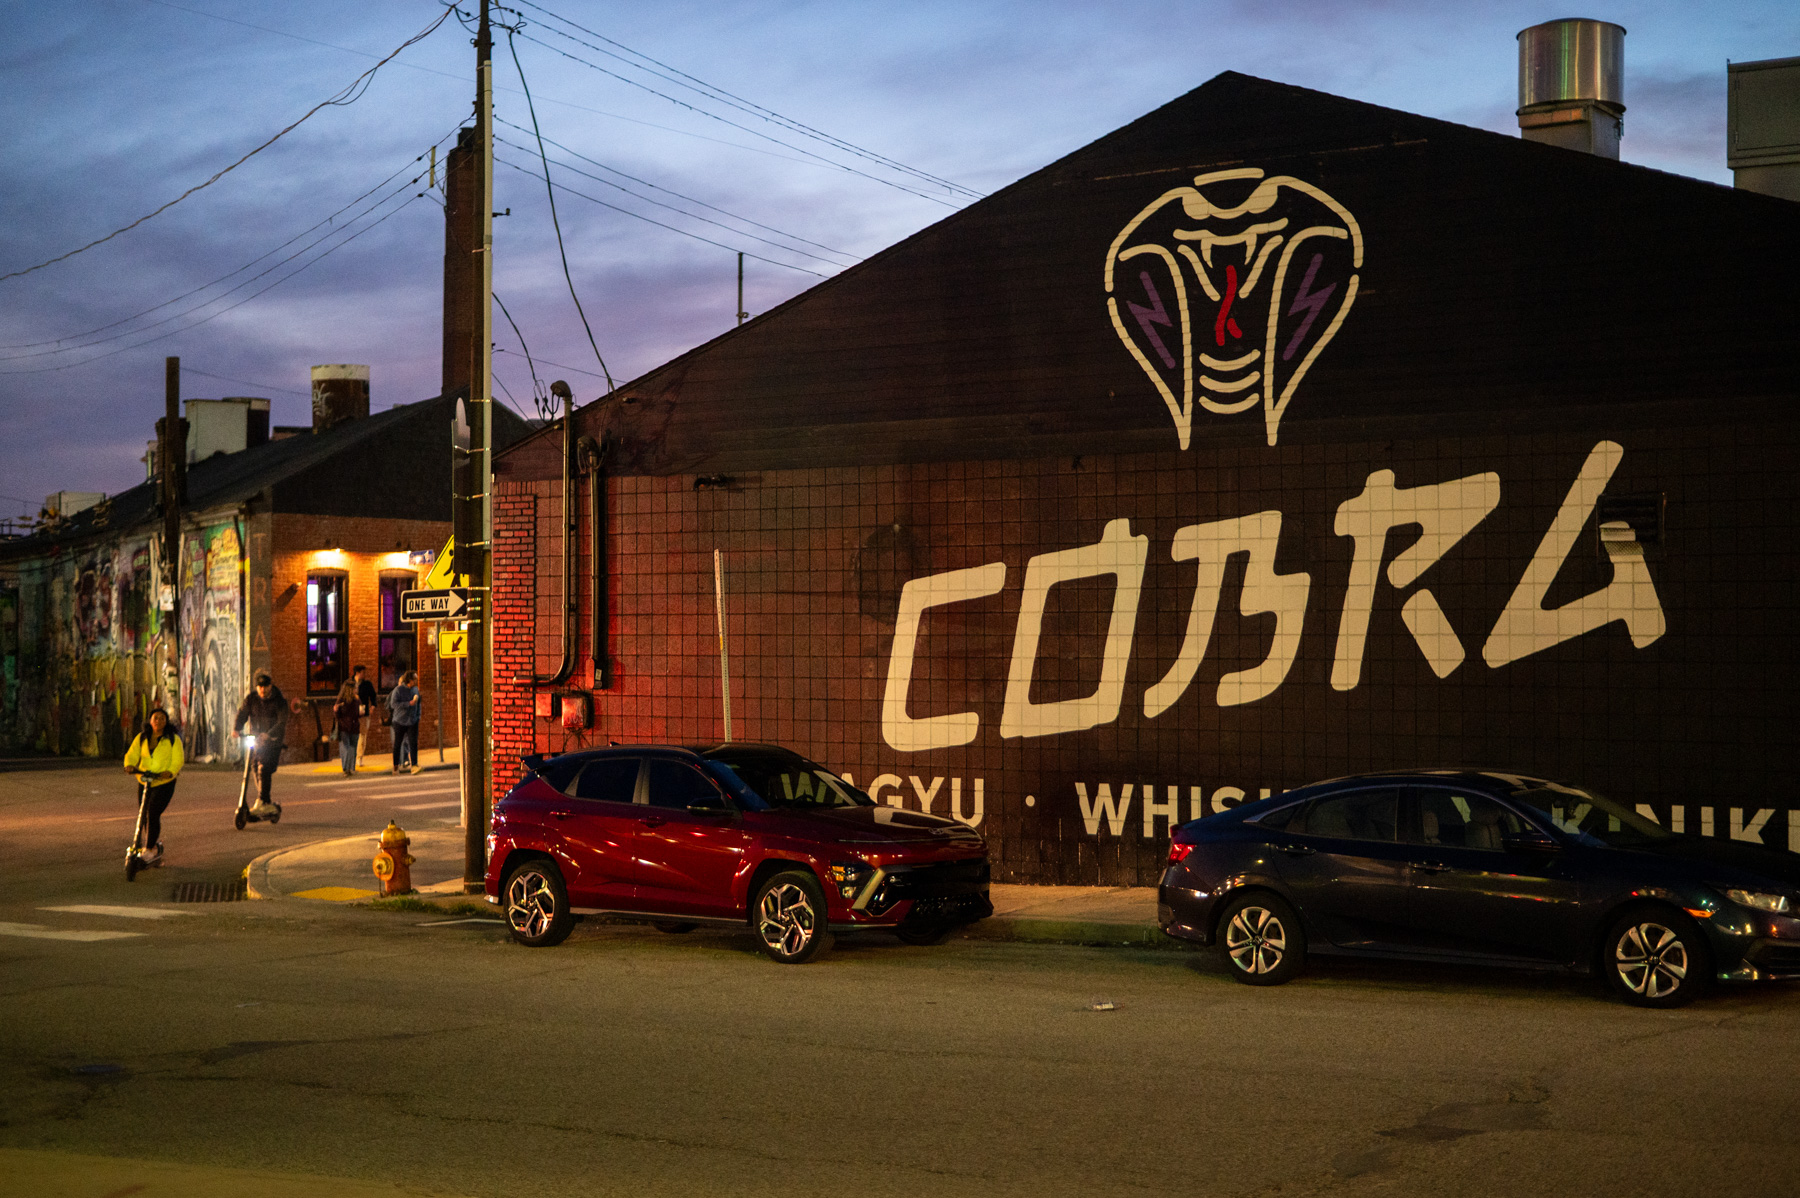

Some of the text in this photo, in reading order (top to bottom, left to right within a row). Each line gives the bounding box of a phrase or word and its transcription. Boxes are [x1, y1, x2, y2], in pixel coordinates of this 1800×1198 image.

[408, 598, 449, 611] ONE WAY
[882, 440, 1666, 751] COBRA
[1074, 781, 1292, 838] WHIS
